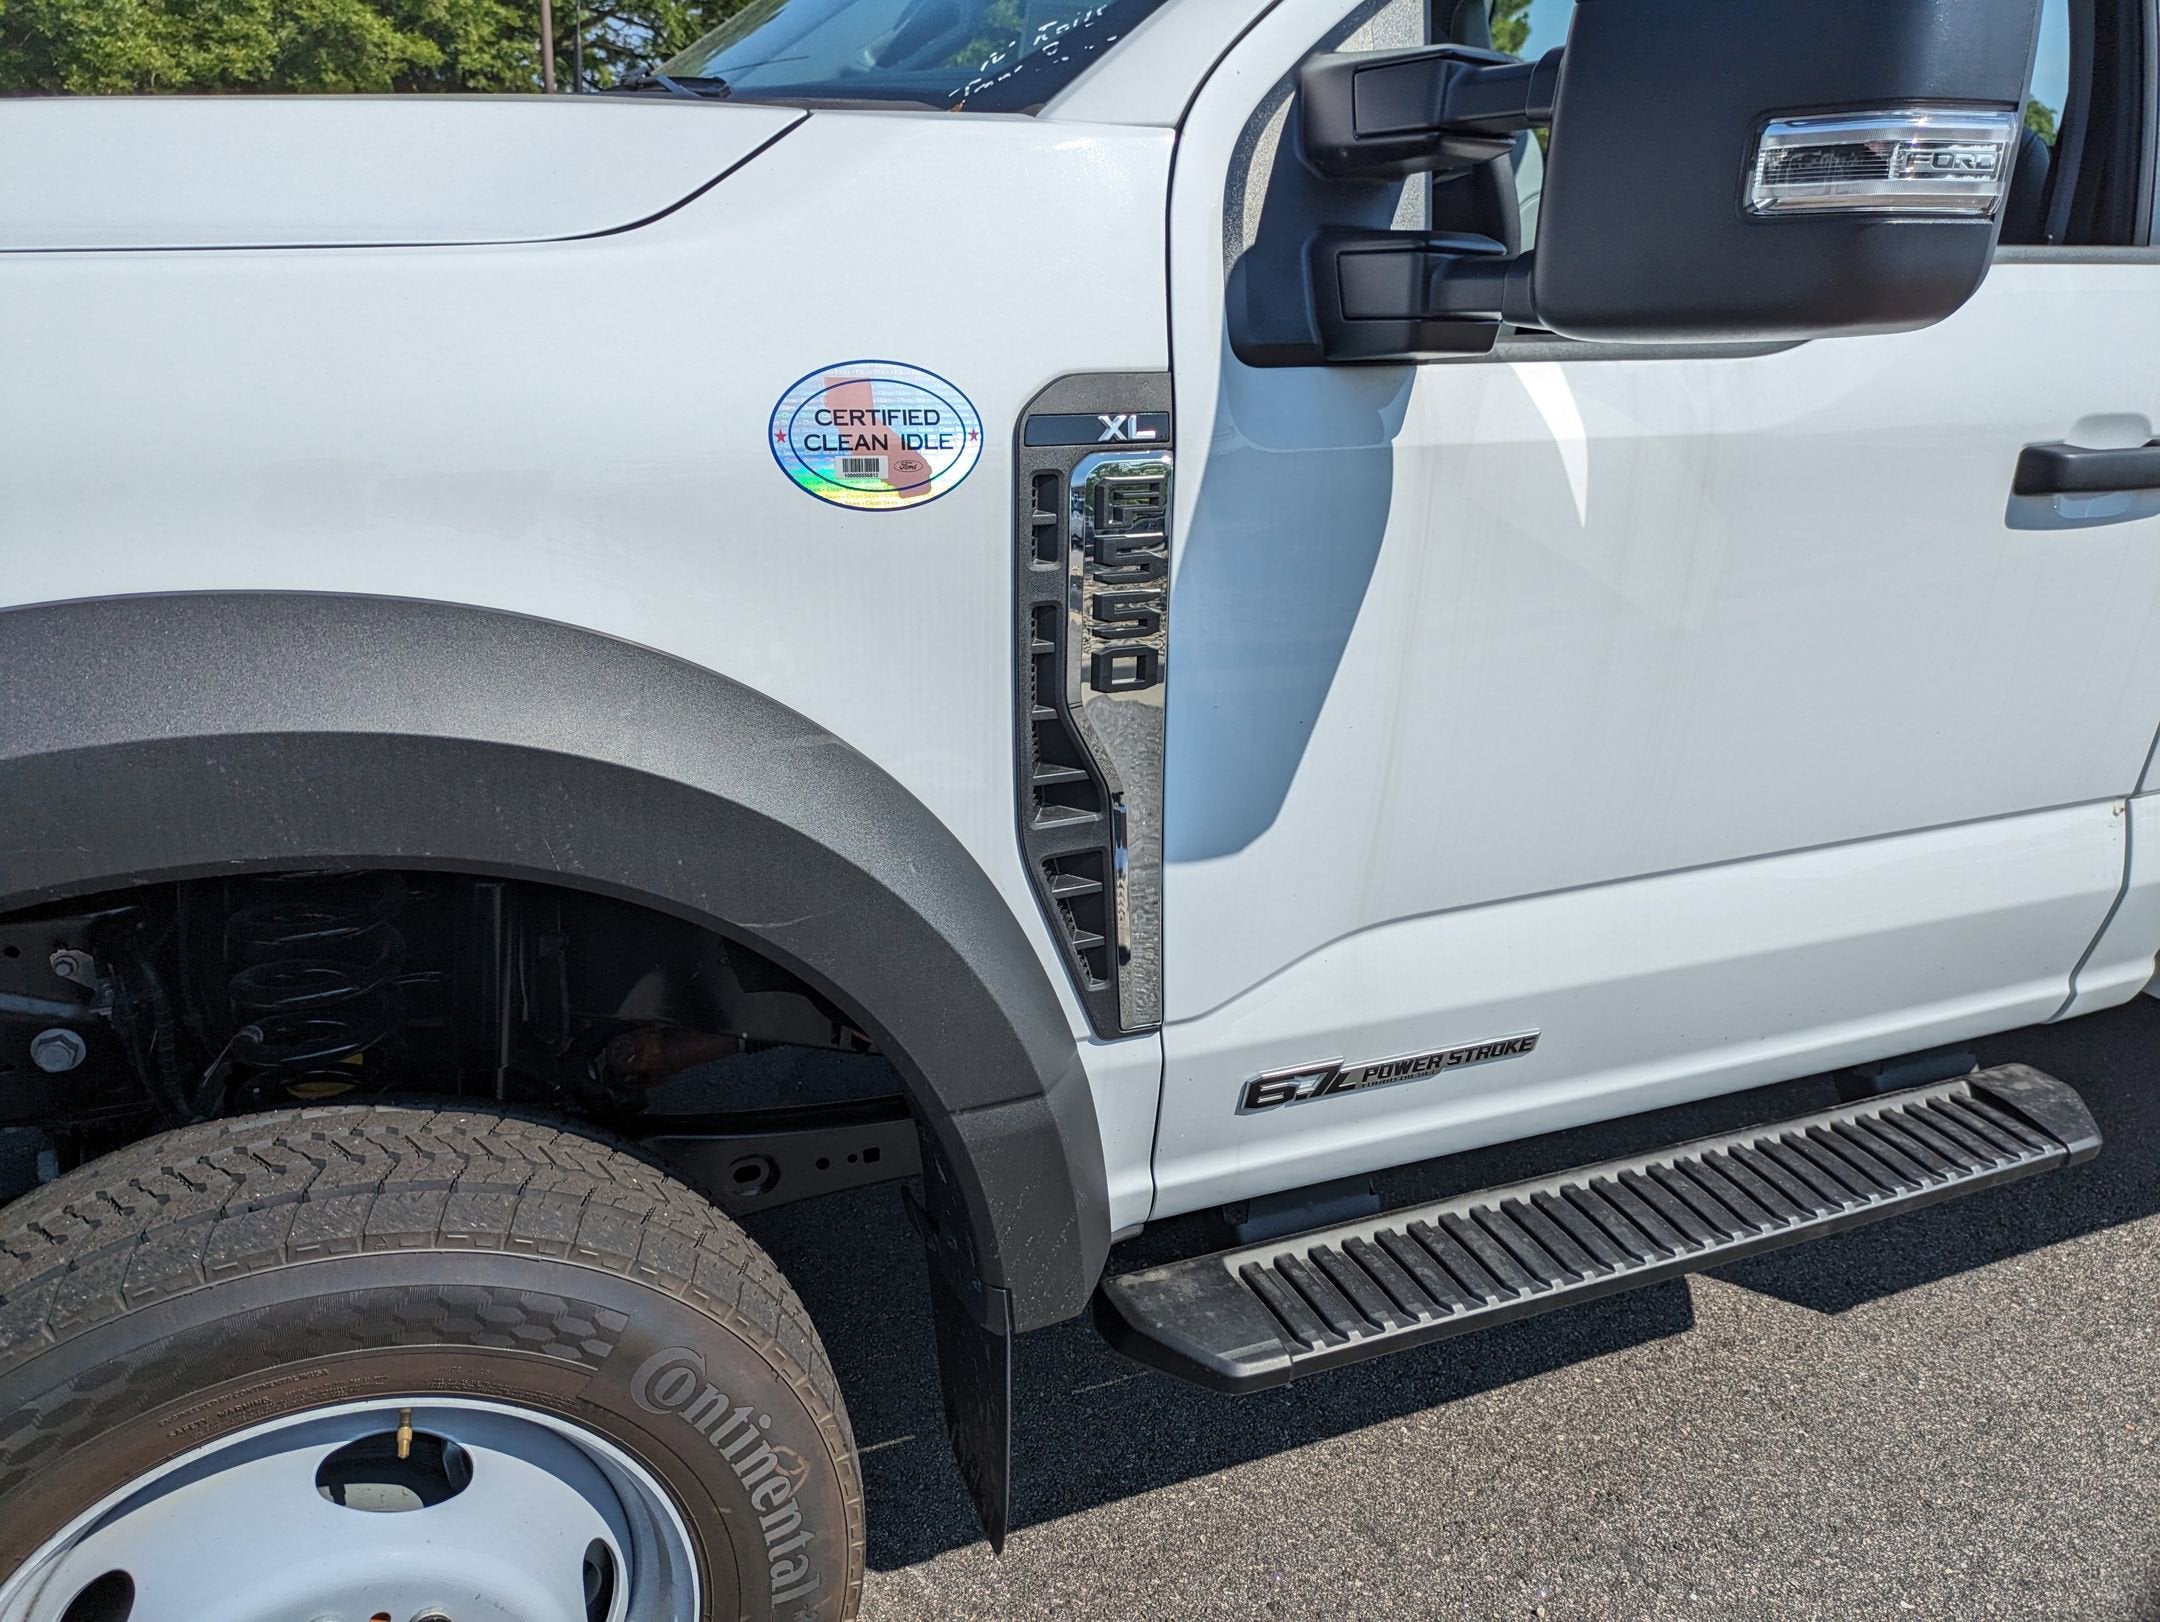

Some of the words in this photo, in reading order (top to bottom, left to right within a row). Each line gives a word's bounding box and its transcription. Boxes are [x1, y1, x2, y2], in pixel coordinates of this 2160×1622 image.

[1906, 151, 1995, 171] FORD
[815, 409, 940, 426] CERTIFIED
[1097, 415, 1156, 442] XL
[804, 434, 888, 451] CLEAN
[901, 433, 953, 450] IDLE
[899, 461, 918, 471] Ford
[1362, 1054, 1444, 1083] POWER
[1448, 1035, 1536, 1066] STROKE
[232, 1374, 300, 1400] CONTINENTAL
[167, 1416, 210, 1439] SAFETY
[217, 1395, 273, 1418] WARNING
[630, 1345, 822, 1609] Continental
